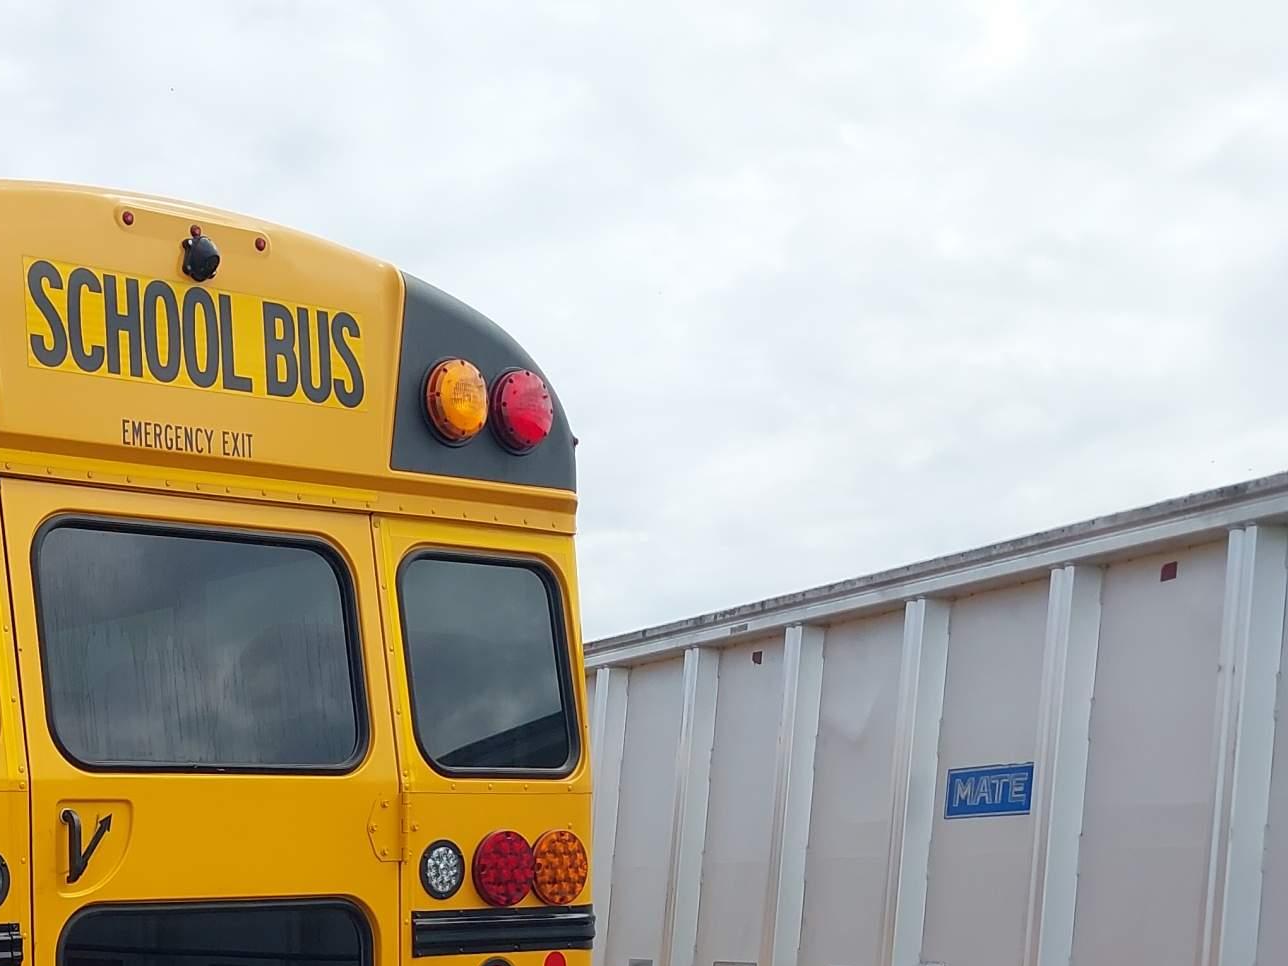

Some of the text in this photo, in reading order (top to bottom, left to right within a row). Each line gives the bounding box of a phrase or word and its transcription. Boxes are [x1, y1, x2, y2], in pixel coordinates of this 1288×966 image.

[27, 260, 365, 408] SCHOOL BUS
[122, 419, 253, 458] EMERGENCY EXIT
[953, 772, 1029, 807] MATE
